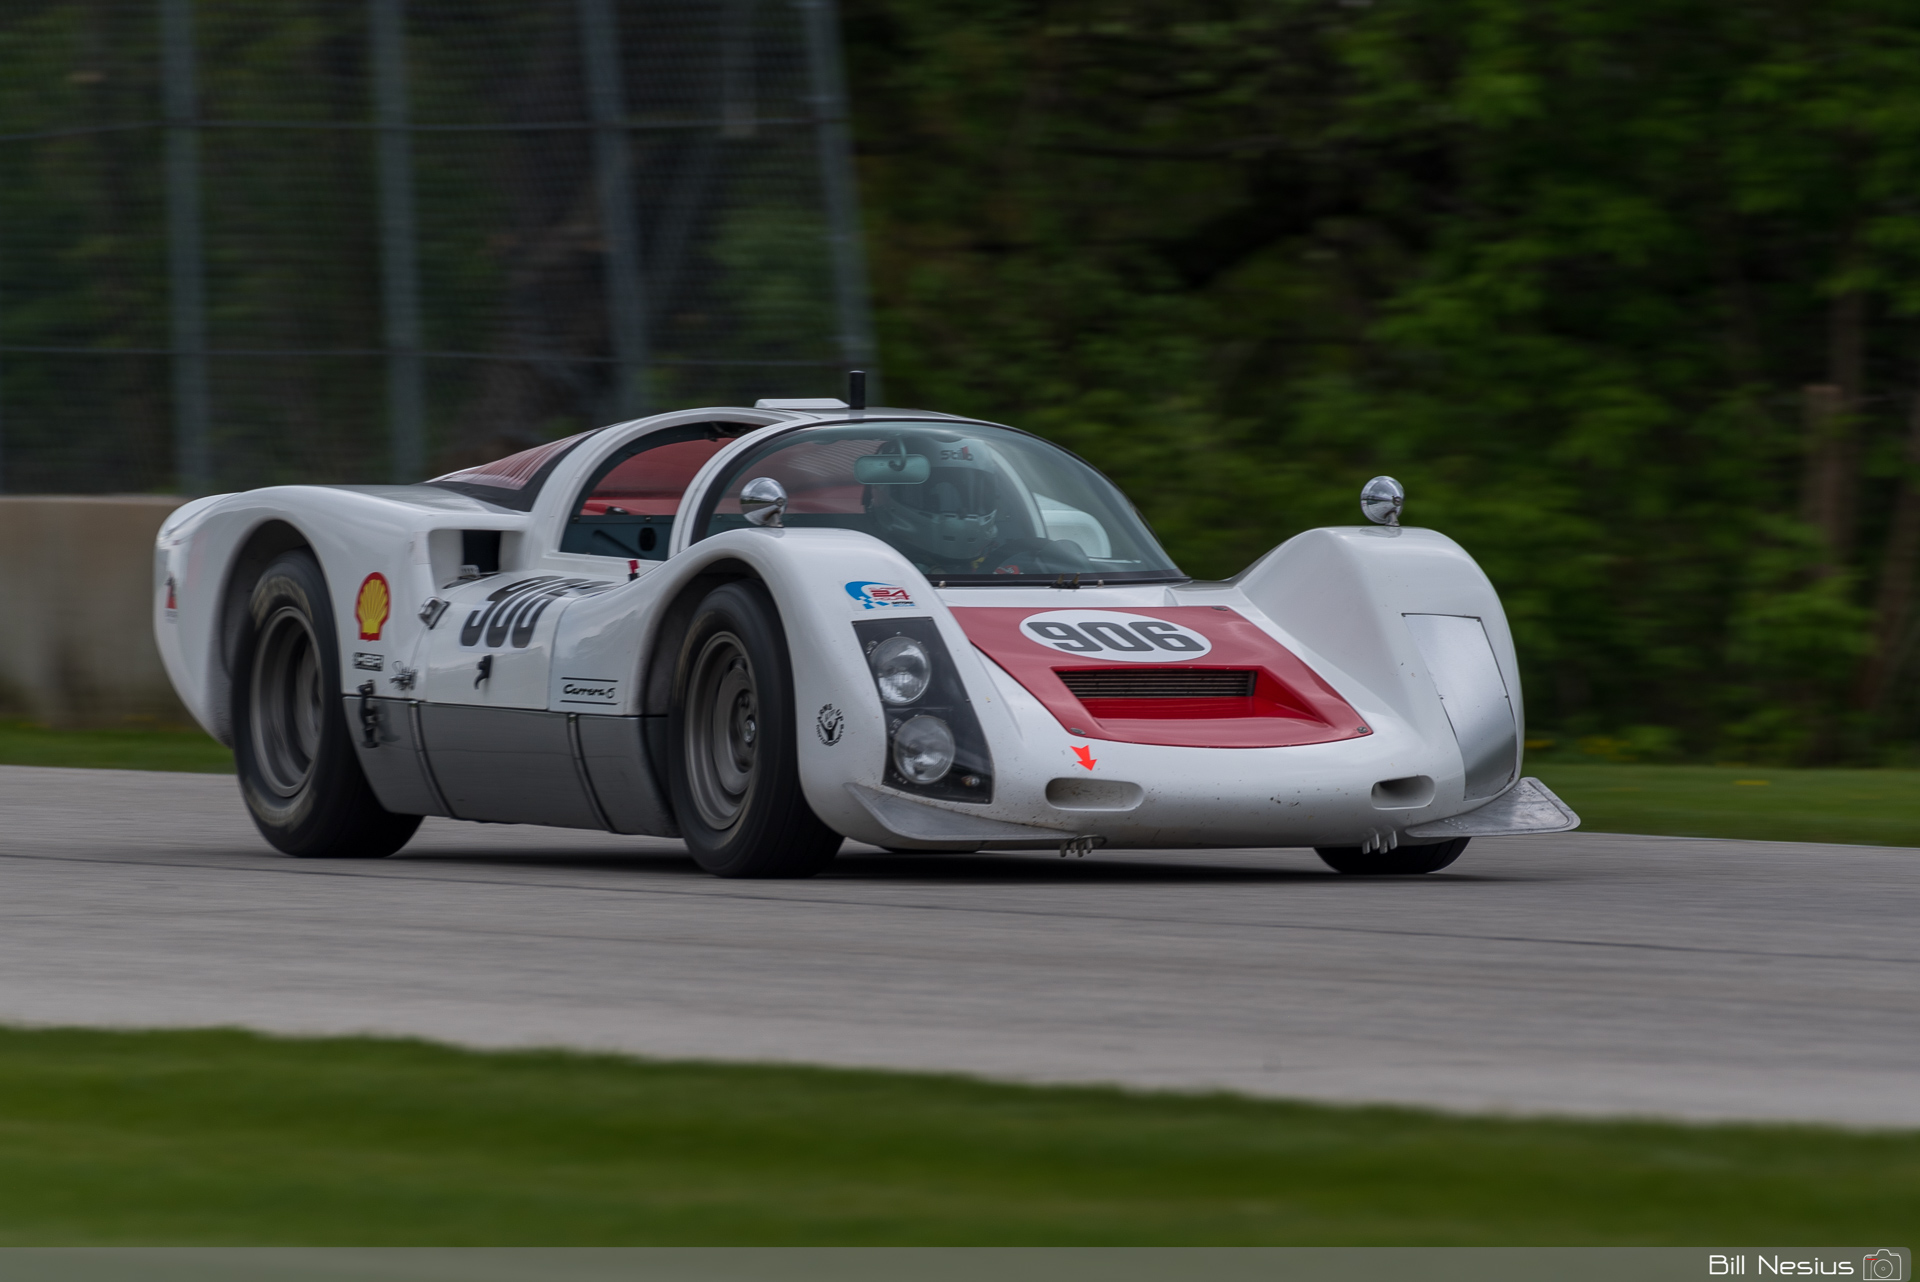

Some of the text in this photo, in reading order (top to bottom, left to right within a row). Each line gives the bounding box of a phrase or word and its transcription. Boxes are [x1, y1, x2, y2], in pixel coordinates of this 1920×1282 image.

[1026, 621, 1206, 652] 906
[563, 683, 616, 699] Carrera 6
